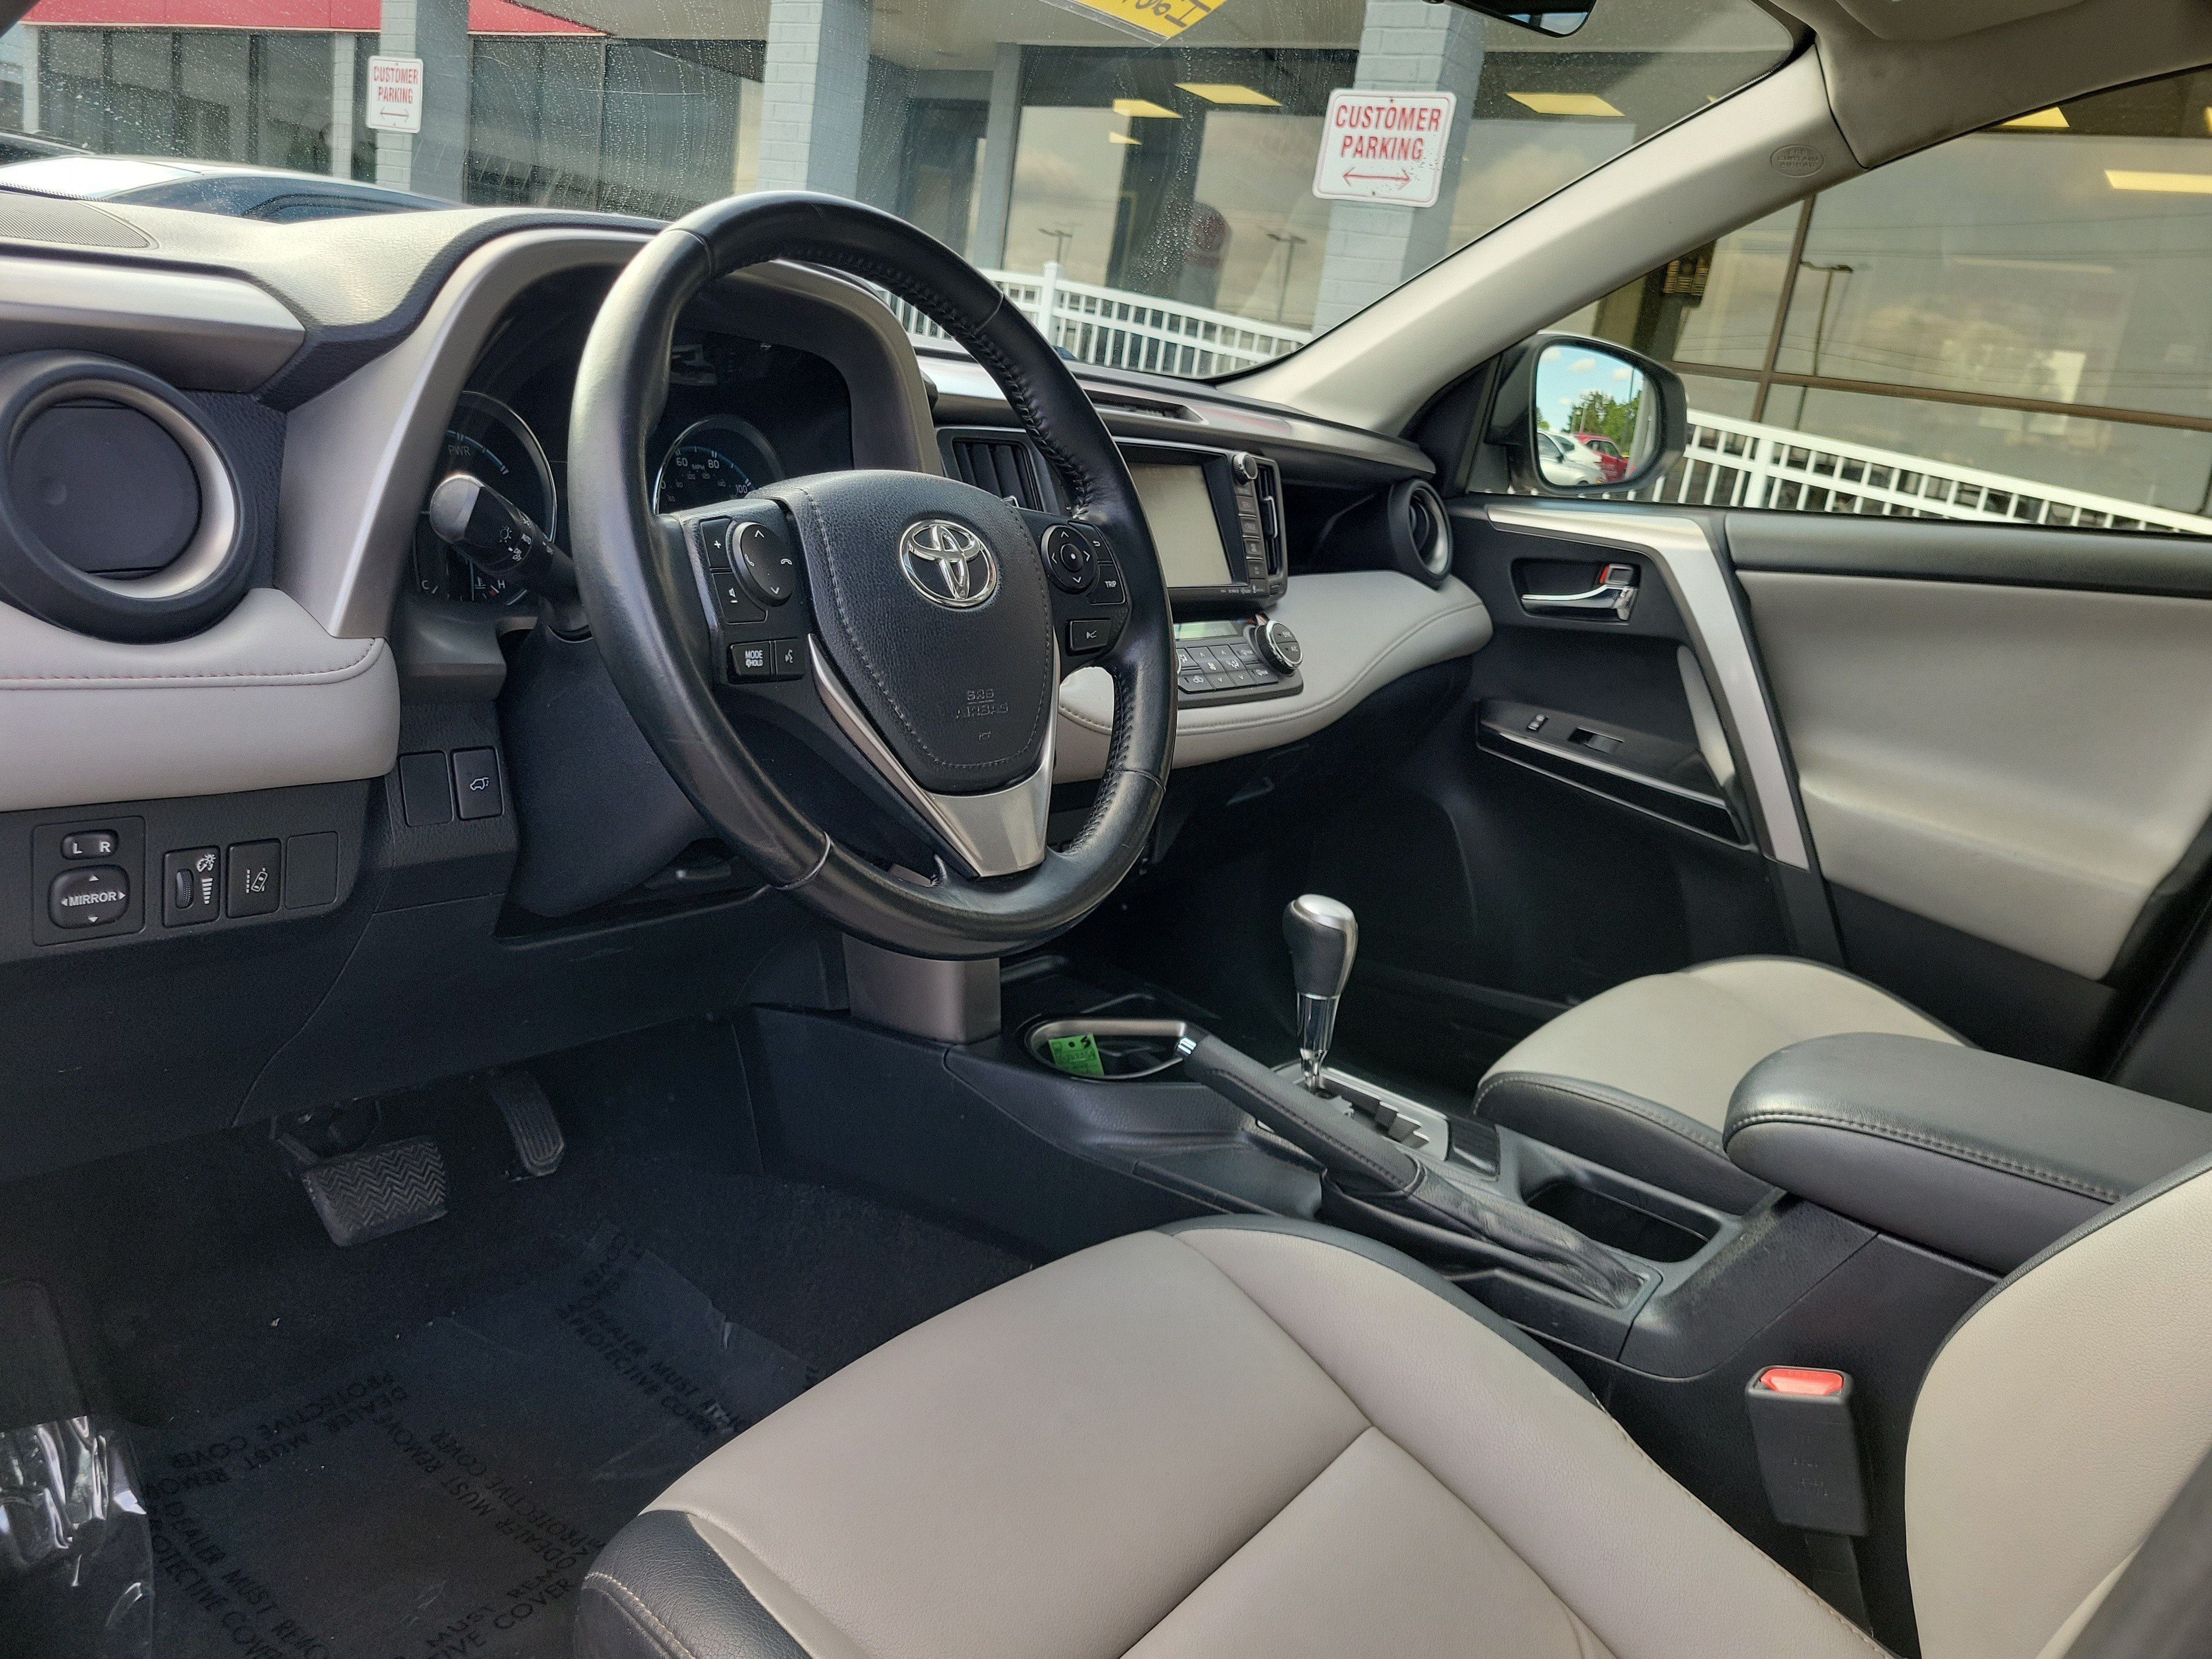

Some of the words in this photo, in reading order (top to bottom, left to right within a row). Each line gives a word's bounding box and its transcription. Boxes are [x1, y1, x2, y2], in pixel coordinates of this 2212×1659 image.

[374, 66, 419, 84] CUSTOMER
[379, 86, 414, 104] PARKING
[1335, 105, 1441, 131] CUSTOMER
[1341, 136, 1424, 161] PARKING
[448, 445, 471, 456] PWR
[676, 458, 688, 466] 60
[708, 460, 719, 469] 80
[736, 484, 748, 494] 100
[422, 580, 430, 589] C
[498, 579, 505, 589] H
[1104, 580, 1117, 589] TRIP
[745, 650, 763, 659] MODE
[966, 689, 995, 701] SRS
[73, 843, 82, 854] L
[100, 841, 111, 852] R
[68, 891, 117, 906] MIRROR
[494, 1578, 577, 1630] COVER
